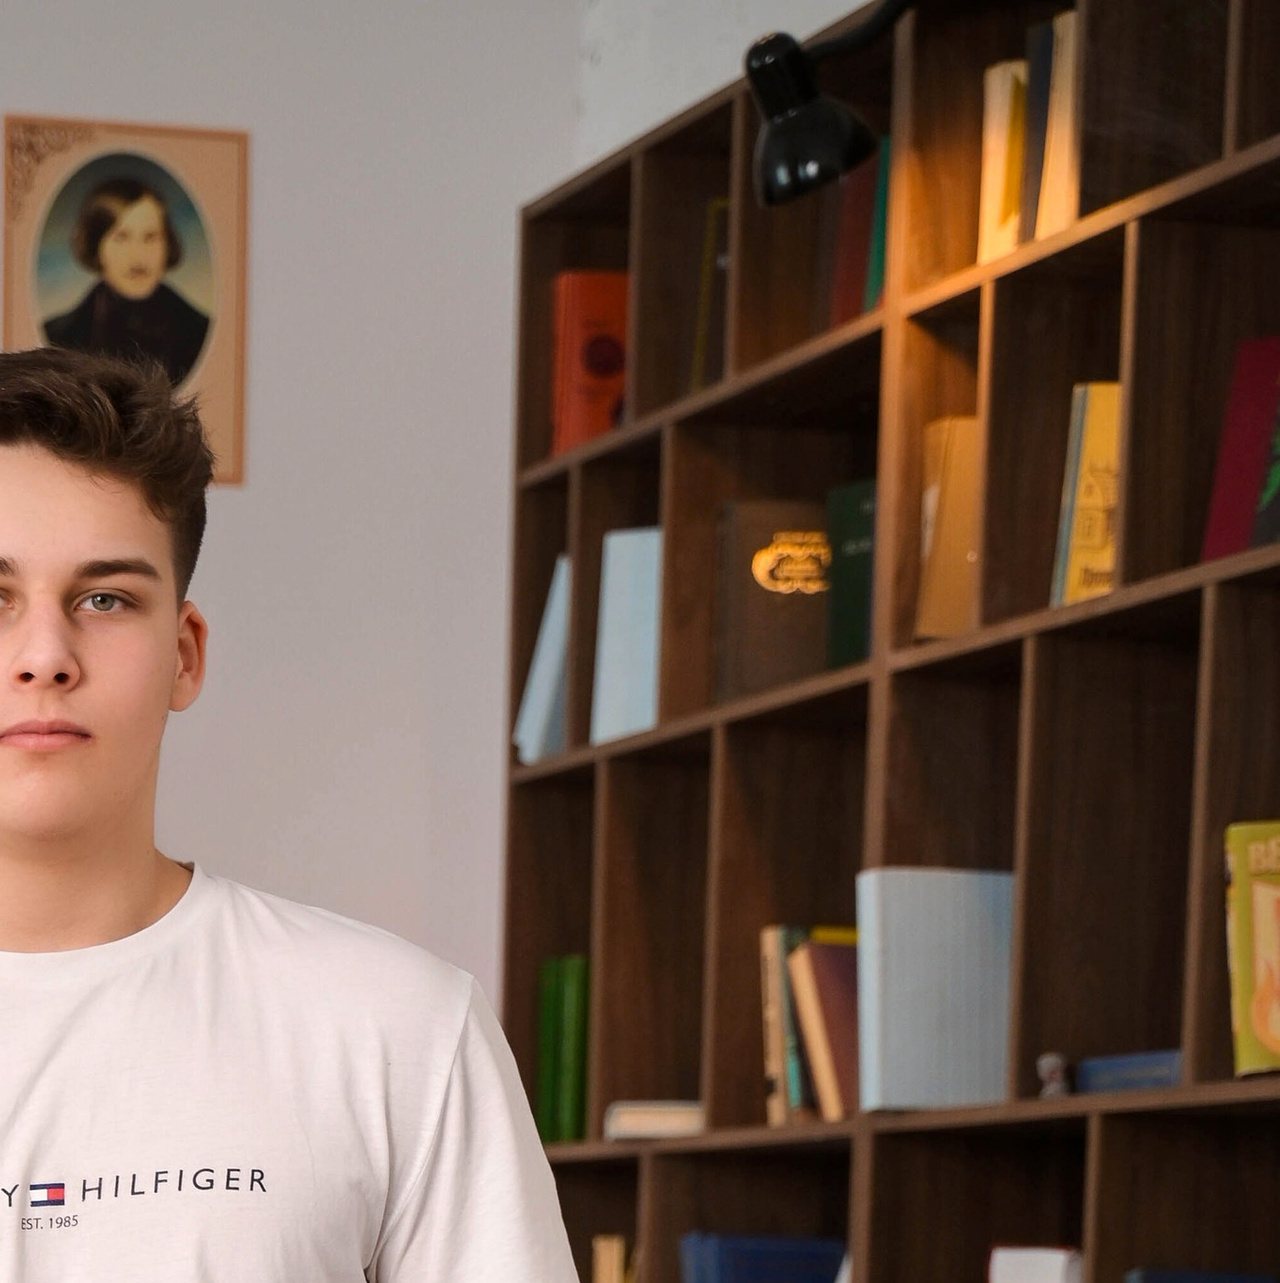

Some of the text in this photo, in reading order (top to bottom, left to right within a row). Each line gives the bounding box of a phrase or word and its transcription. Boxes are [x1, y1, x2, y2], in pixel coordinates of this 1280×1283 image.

[81, 1168, 267, 1202] HILFIGER
[21, 1214, 79, 1230] EST. 1985
